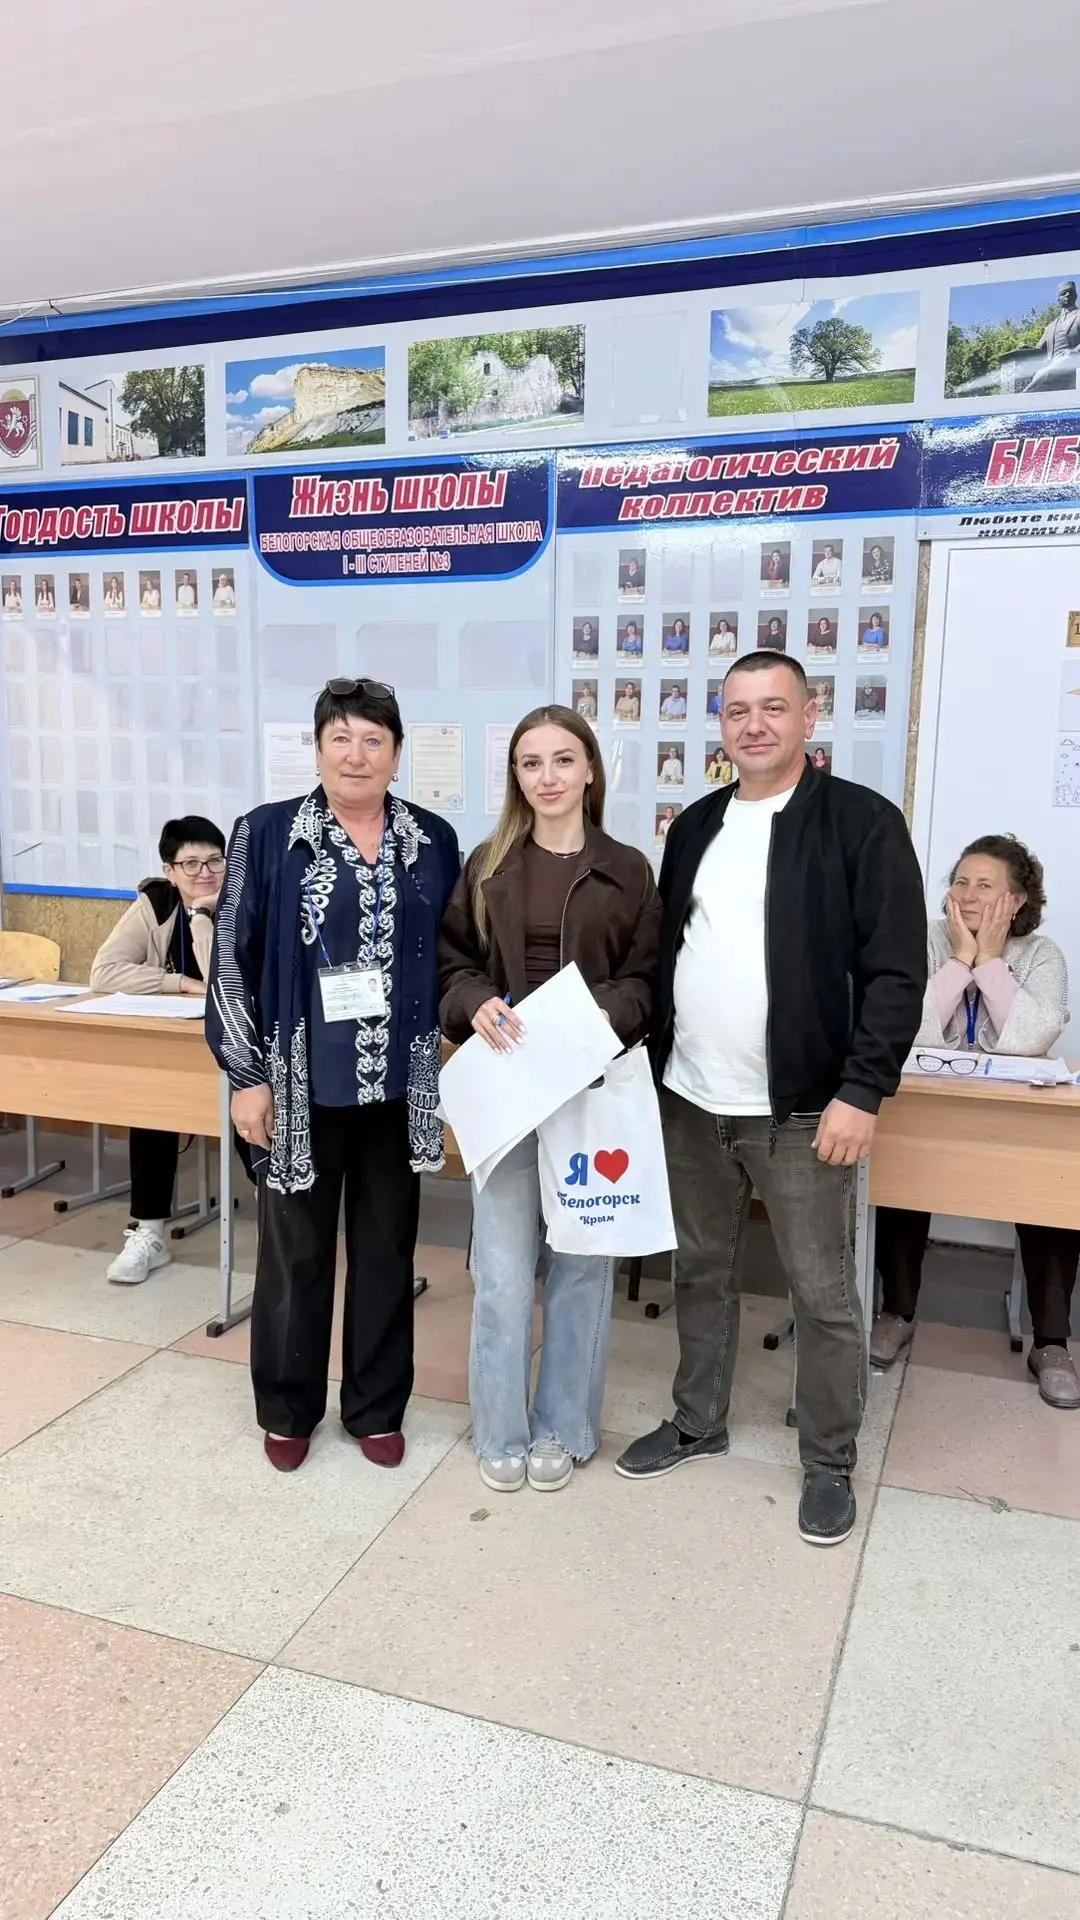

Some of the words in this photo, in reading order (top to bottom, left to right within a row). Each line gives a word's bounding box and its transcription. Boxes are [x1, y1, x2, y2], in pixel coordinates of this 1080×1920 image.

[579, 437, 900, 489] Педагогический
[985, 435, 1080, 488] БИБ
[289, 474, 389, 518] Жизнь
[391, 470, 509, 513] школы
[618, 484, 828, 521] коллектив
[129, 497, 245, 535] школы
[959, 514, 1042, 526] Любите
[260, 531, 341, 552] БЕЛОГОРСКАЯ
[342, 523, 495, 552] ОБЩЕОБРАЗОВАТЕЛЬНАЯ
[496, 521, 543, 543] ШКОЛА
[367, 548, 429, 573] СТУПЕНЕЙ
[564, 1152, 588, 1186] Я
[557, 1191, 641, 1208] Белогорск
[580, 1215, 615, 1226] Крым
